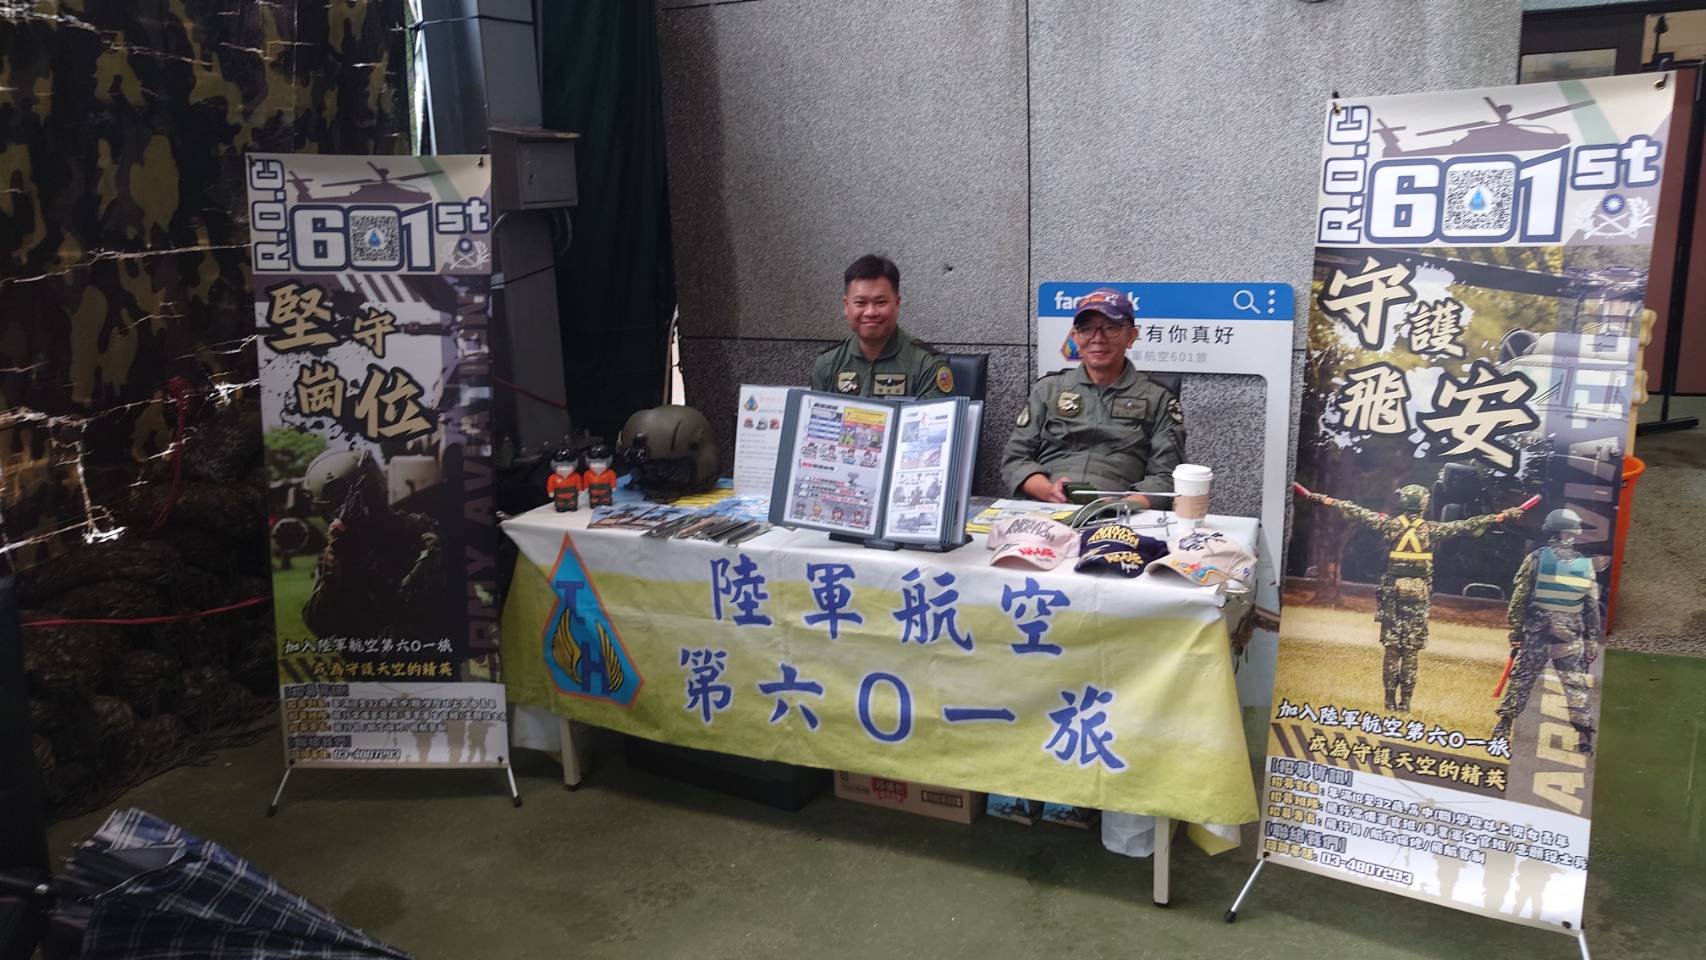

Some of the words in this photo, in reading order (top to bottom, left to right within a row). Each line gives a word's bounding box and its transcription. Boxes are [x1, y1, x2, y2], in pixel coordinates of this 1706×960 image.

[250, 158, 290, 271] R.O.C
[1318, 104, 1370, 244] R.O.C
[266, 283, 397, 357] 堅守
[1054, 291, 1140, 311] fack
[1320, 255, 1467, 360] 守護
[296, 362, 438, 441] 崗位
[1338, 361, 1541, 470] 飛安
[710, 553, 1073, 657] 陸軍航空
[1309, 734, 1508, 790] 成為守護天空的精英
[1320, 852, 1413, 885] 03-4807293
